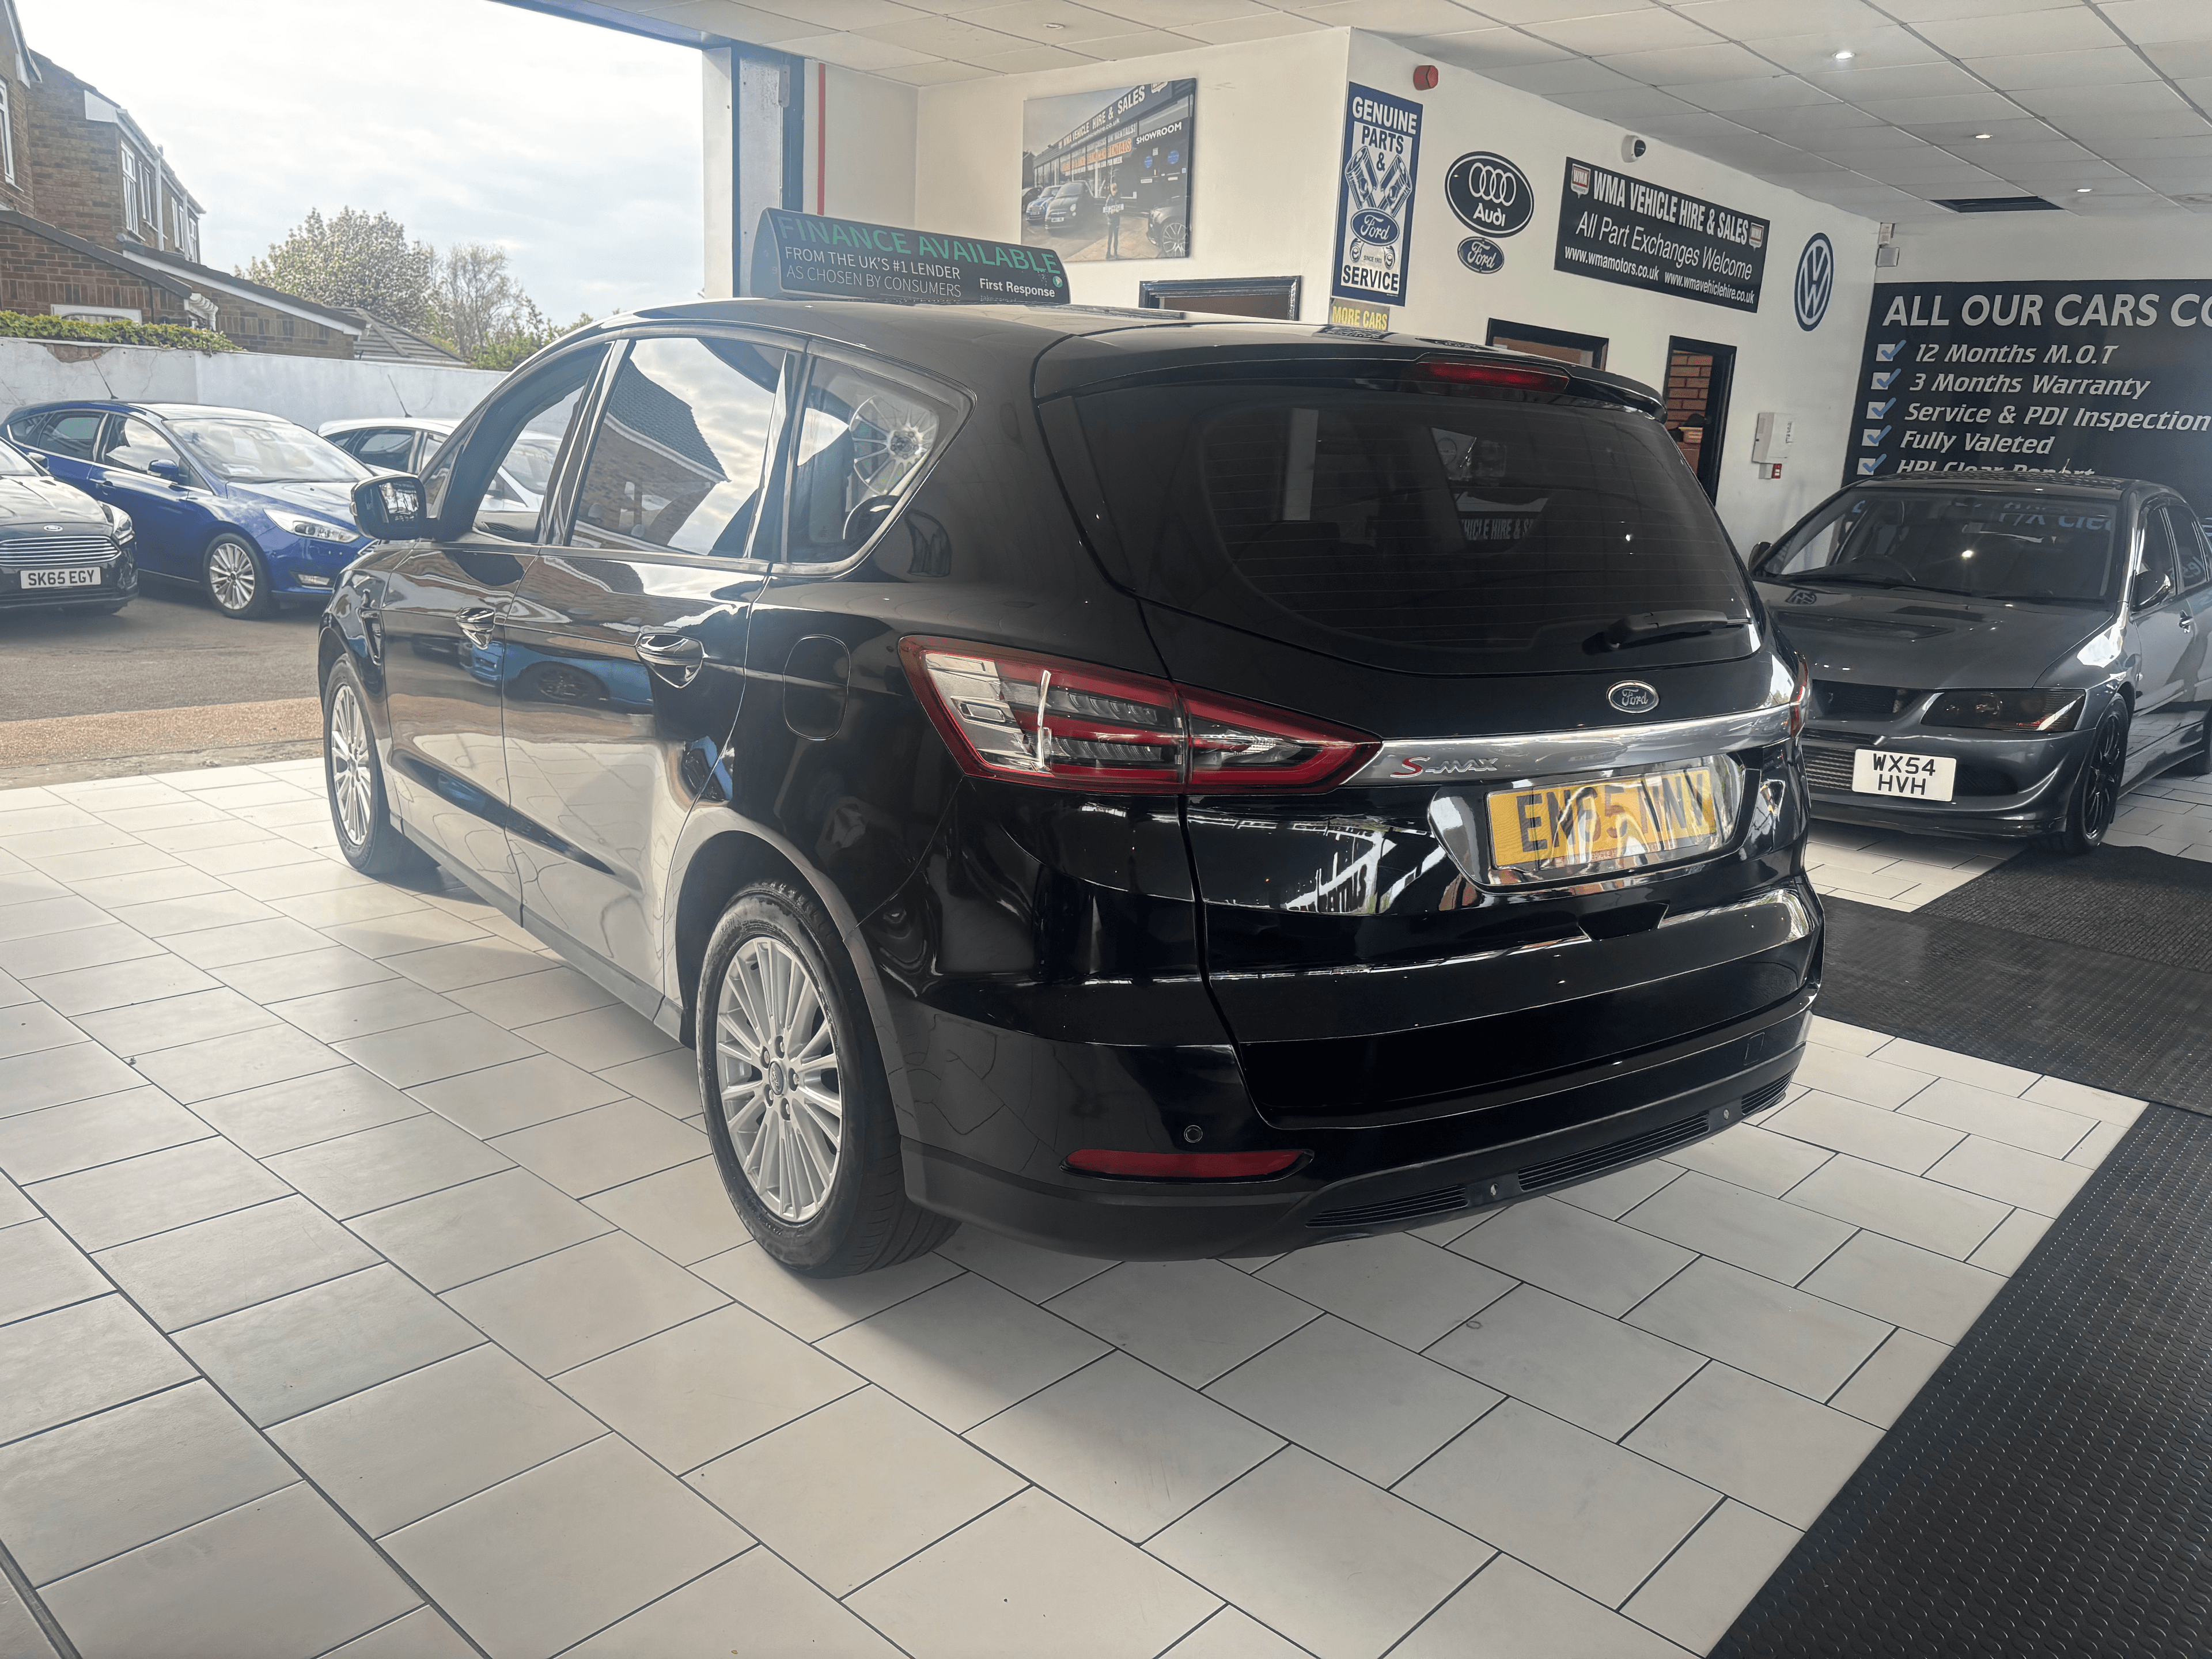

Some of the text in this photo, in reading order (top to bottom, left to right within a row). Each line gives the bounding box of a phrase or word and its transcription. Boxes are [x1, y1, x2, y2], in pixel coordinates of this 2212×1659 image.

[1093, 111, 1106, 130] HIRE
[1108, 106, 1114, 120] &
[1118, 85, 1145, 115] SALES
[1352, 97, 1417, 135] GENUINE
[1136, 122, 1182, 145] SHOWROOM
[1361, 125, 1404, 154] PARTS
[1376, 152, 1385, 172] &
[1473, 203, 1506, 226] Audi
[1593, 171, 1749, 245] WMA VEHICLE HIRE & SALES
[1360, 215, 1391, 240] Ford
[777, 217, 1060, 275] FINANCE AVAILABLE
[1468, 241, 1497, 268] Ford
[1575, 211, 1752, 281] All Part Exchanges Welcome
[785, 247, 961, 280] FROM THE UK'S #1 LENDER
[1565, 246, 1755, 304] www.wmamotors.co.uk www.wmavehiclehire.co.uk
[786, 265, 804, 279] AS
[807, 266, 862, 286] CHOSEN
[866, 273, 881, 288] BY
[884, 275, 961, 298] CONSUMERS
[980, 278, 1055, 298] First Response
[1343, 265, 1399, 291] SERVICE
[1332, 306, 1388, 330] MORE CARS
[1882, 295, 1950, 327] ALL
[1961, 294, 2044, 327] OUR
[2054, 293, 2160, 327] CARS
[1915, 344, 2119, 364] 12 Months M.O.T
[1910, 373, 2152, 400] 3 Months Warranty
[1904, 403, 2211, 431] Service & PDI Inspection
[1900, 430, 2055, 454] Fully Valeted
[28, 570, 94, 586] SK65 EGY
[1621, 689, 1649, 706] Ford
[1873, 753, 1936, 776] WX54
[1878, 774, 1926, 795] HVH
